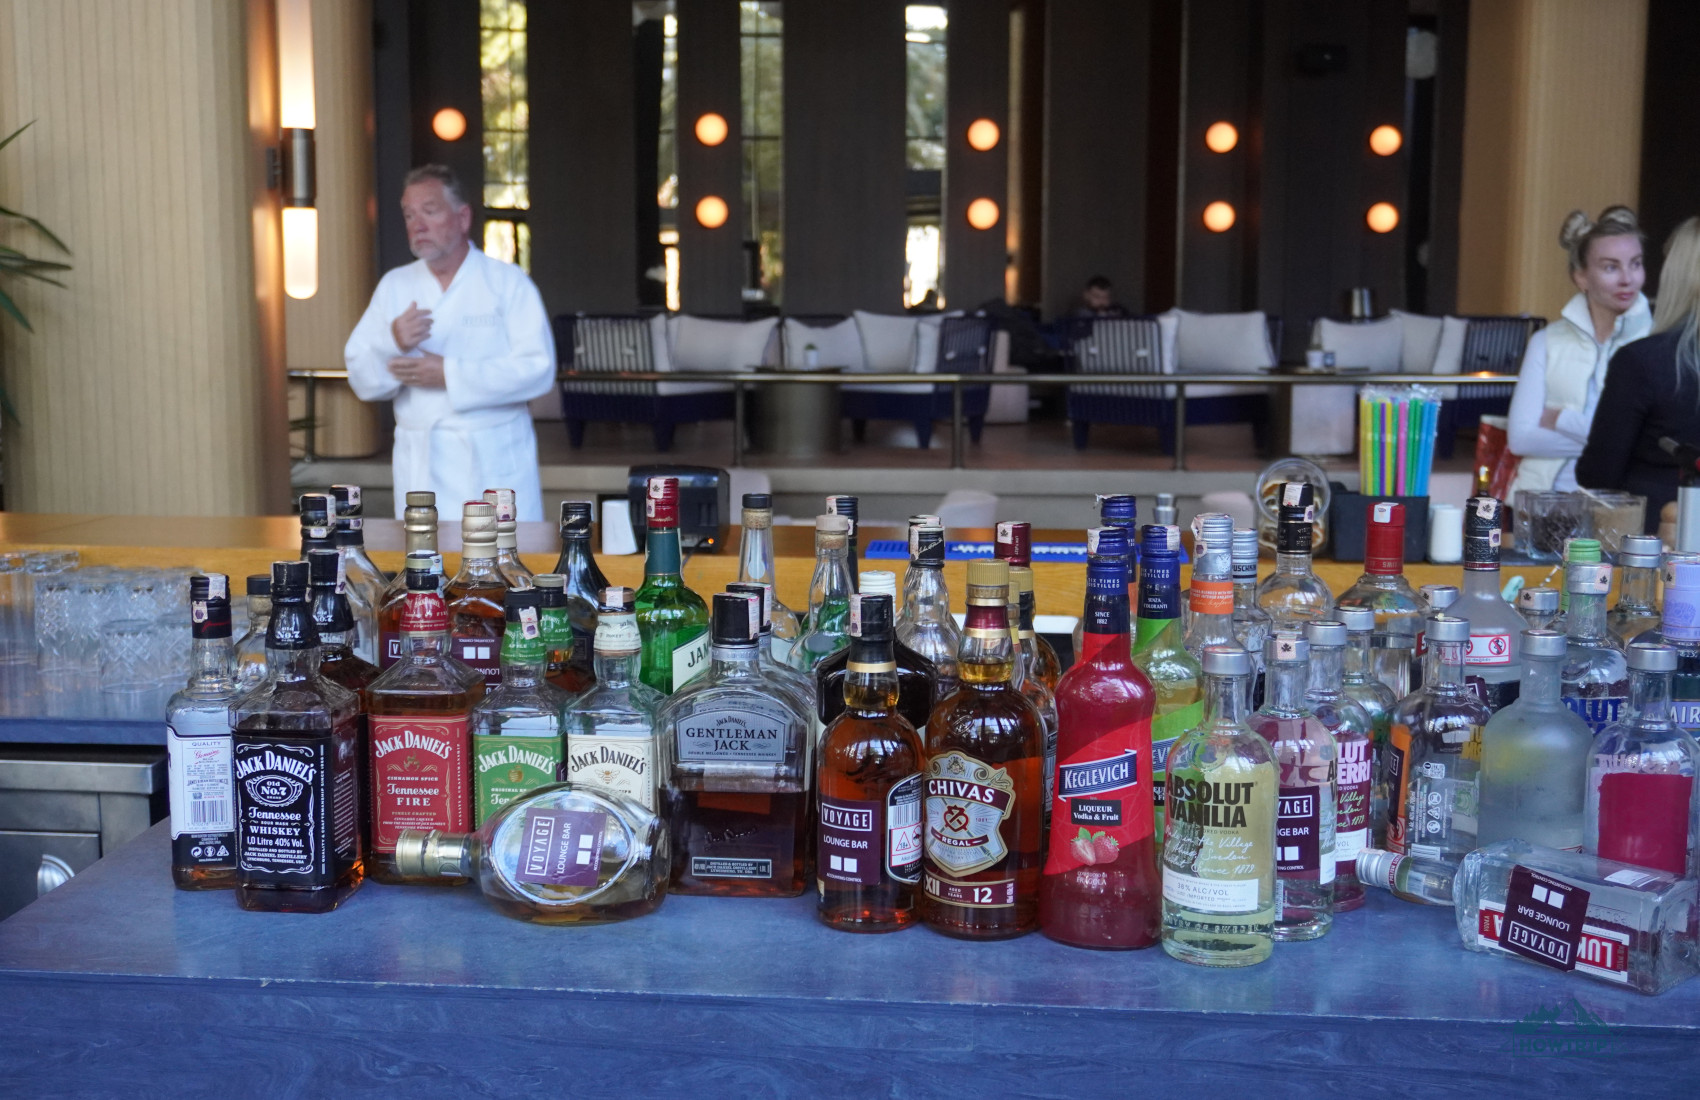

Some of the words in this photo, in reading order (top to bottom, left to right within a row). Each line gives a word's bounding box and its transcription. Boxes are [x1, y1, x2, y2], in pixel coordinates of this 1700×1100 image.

[276, 631, 301, 639] No.7
[685, 727, 778, 740] GENTLEMAN
[374, 735, 404, 758] JACK
[404, 730, 453, 759] DANIEL'S
[714, 740, 751, 751] JACK
[235, 755, 265, 780] JACK
[265, 750, 317, 783] DANIEL'S
[478, 750, 508, 773] JACK
[508, 745, 556, 775] DANIEL'S
[571, 750, 597, 773] JACK
[600, 746, 647, 775] DANIEL'S
[1064, 762, 1129, 789] KEGLEVICH
[260, 785, 288, 797] No.7
[386, 783, 440, 796] Tennessee
[928, 780, 996, 804] CHIVAS
[1167, 773, 1254, 805] ABSOLUT
[396, 797, 431, 807] FIRE
[1078, 804, 1113, 813] LIQUEUR
[1278, 800, 1309, 814] AGE
[248, 806, 302, 821] Tennessee
[823, 807, 868, 827] VOYAGE
[1073, 812, 1093, 820] Vodka
[1093, 813, 1100, 821] &
[1101, 813, 1119, 821] Fruit
[1169, 801, 1247, 828] VANILIA
[249, 825, 301, 837] WHISKEY
[562, 822, 572, 839] BAR
[1292, 827, 1309, 836] BAR
[257, 836, 273, 846] Litre
[274, 838, 291, 847] 40%
[291, 838, 305, 848] Vol.
[529, 820, 551, 871] VOYAGE
[823, 834, 850, 848] LOUNGE
[851, 840, 868, 849] BAR
[941, 836, 971, 847] REGAL
[1219, 837, 1254, 853] Village
[556, 840, 569, 874] LOUNGE
[826, 872, 846, 881] ACCOUNTING
[1530, 872, 1549, 884] CONTROL
[925, 875, 940, 896] XII
[1177, 882, 1191, 892] 38%
[1192, 887, 1229, 896] ALC/VOL
[1549, 878, 1573, 892] ACCOUNTING
[973, 887, 993, 904] 12
[1187, 894, 1215, 902] IMPORTED
[1517, 904, 1534, 918] BAR
[1535, 915, 1570, 932] LOUNGE
[1511, 926, 1564, 959] VOYAGE
